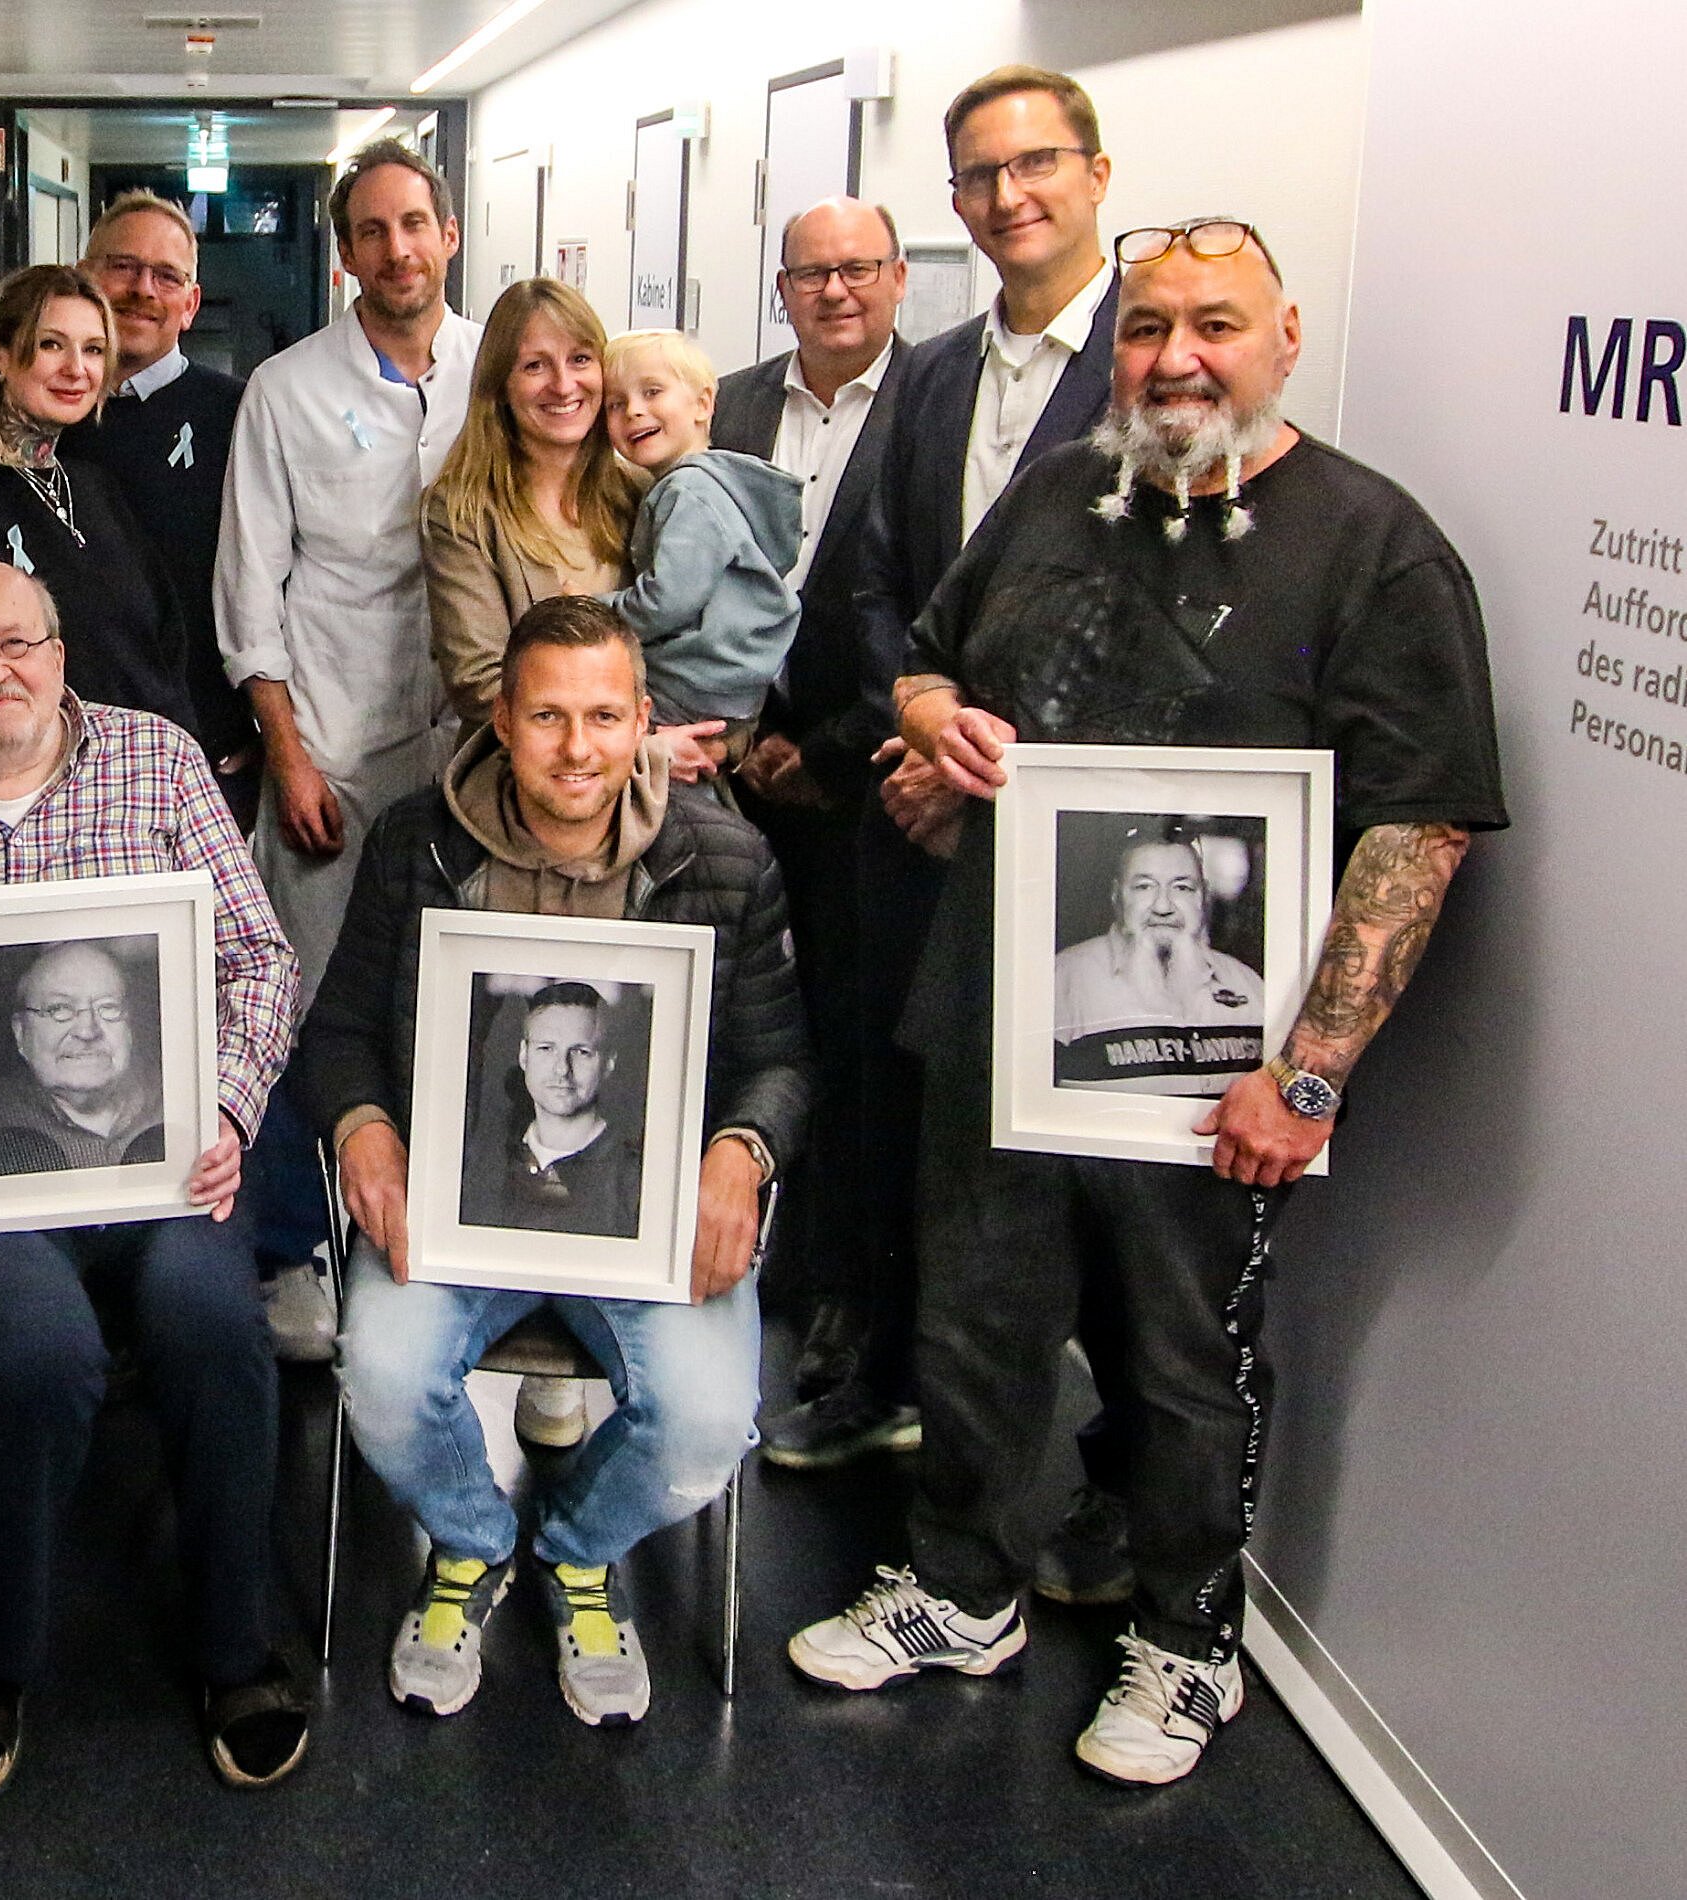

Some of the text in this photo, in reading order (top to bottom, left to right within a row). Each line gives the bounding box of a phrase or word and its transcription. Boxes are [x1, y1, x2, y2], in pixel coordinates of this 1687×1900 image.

[637, 273, 673, 309] Kabine 1
[1589, 518, 1684, 575] Zutritt
[1577, 639, 1624, 687] des
